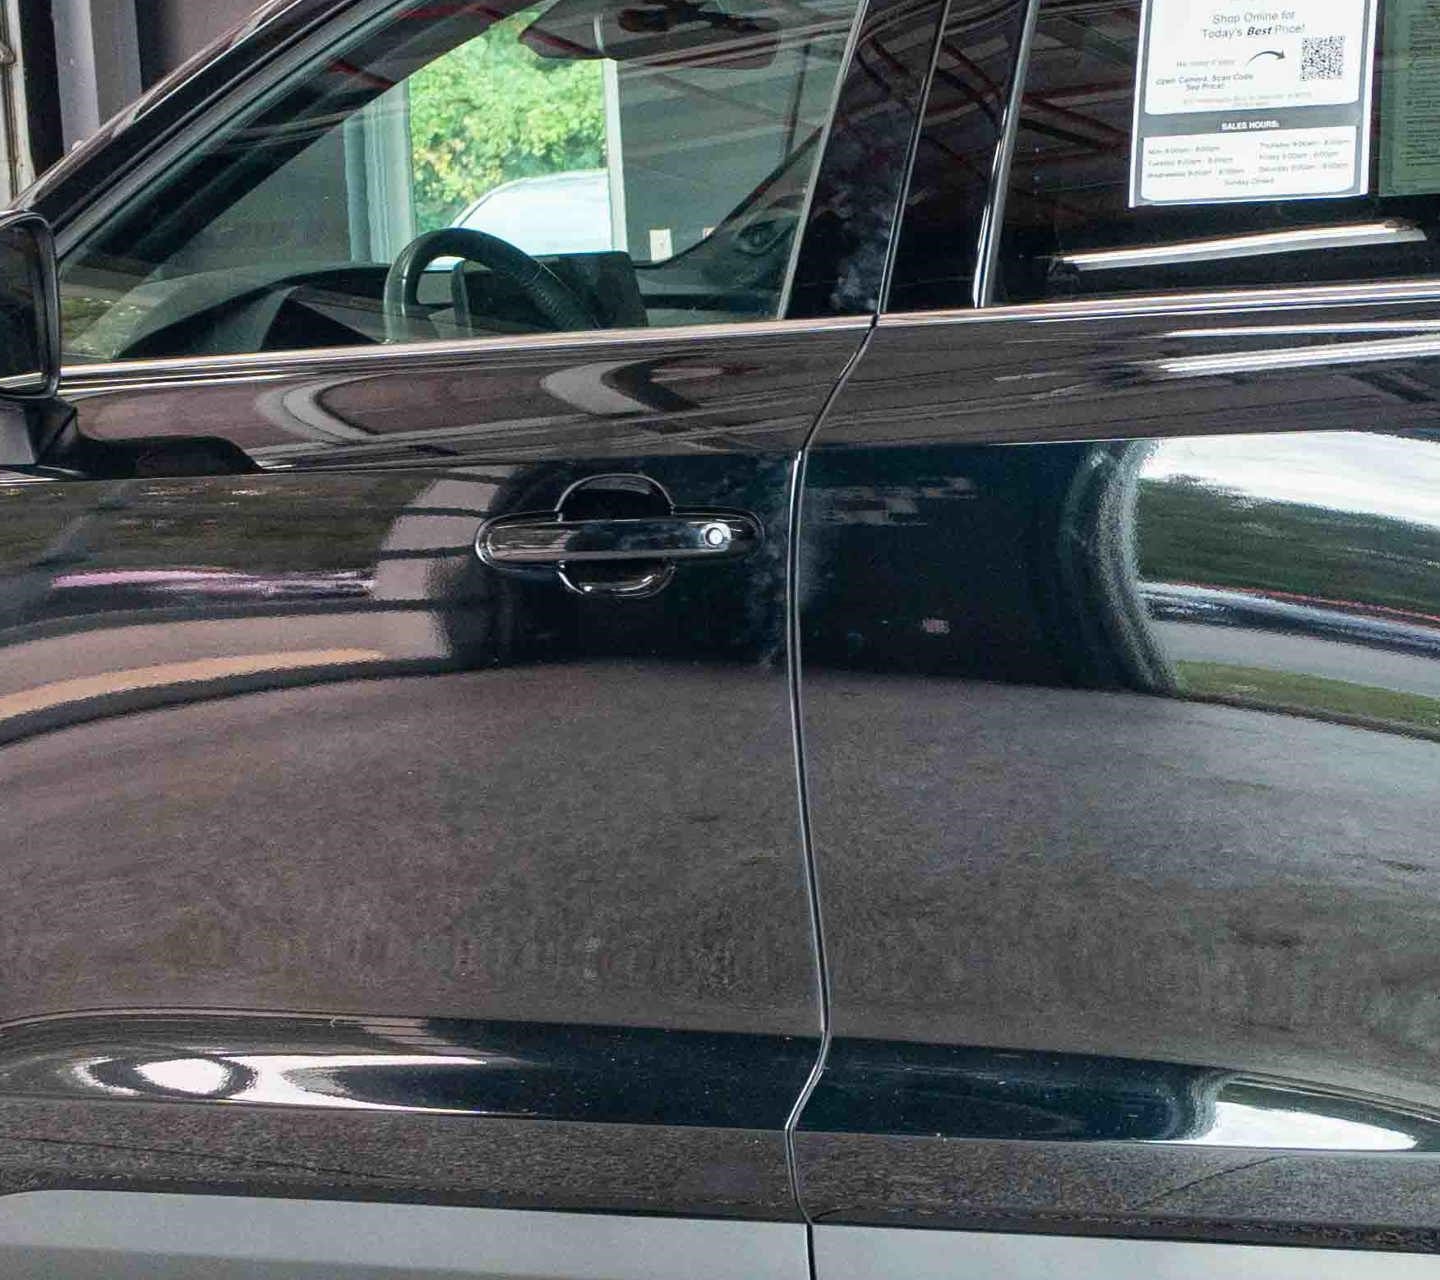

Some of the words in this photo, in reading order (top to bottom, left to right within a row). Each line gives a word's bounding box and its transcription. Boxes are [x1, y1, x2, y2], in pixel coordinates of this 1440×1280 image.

[1212, 14, 1241, 27] Shop
[1243, 11, 1278, 24] Online
[1280, 9, 1295, 21] for
[1202, 26, 1243, 41] Today's
[1246, 25, 1273, 37] Best
[1274, 23, 1306, 36] Price!
[1220, 121, 1248, 132] SALES
[1249, 120, 1281, 130] HOURS:
